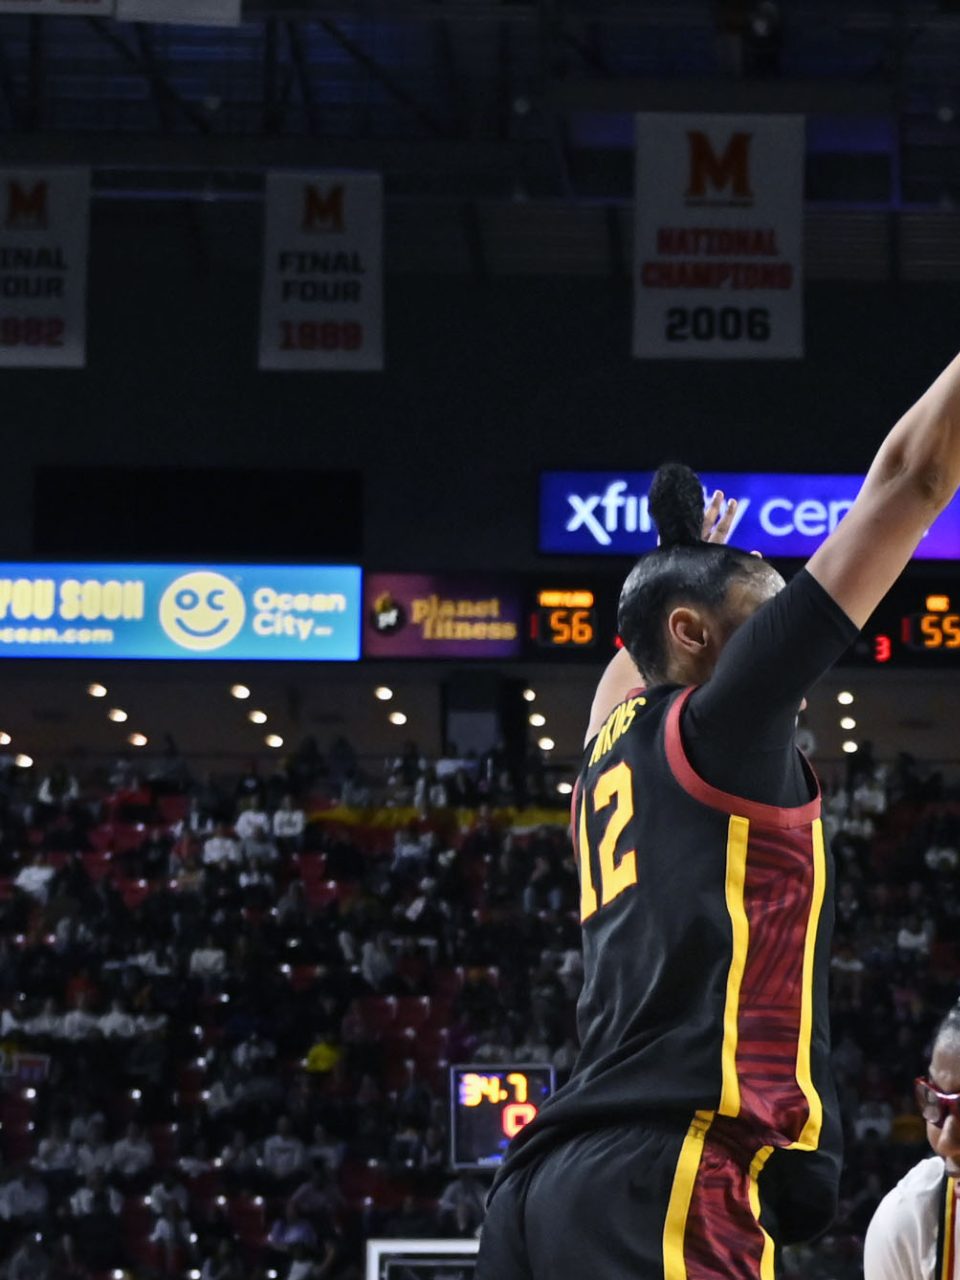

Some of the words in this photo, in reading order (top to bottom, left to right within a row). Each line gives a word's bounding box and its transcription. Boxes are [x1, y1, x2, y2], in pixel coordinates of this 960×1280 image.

[687, 130, 752, 200] M
[304, 183, 344, 232] M
[656, 228, 778, 256] NATIONAL
[278, 251, 365, 274] FINAL
[642, 262, 793, 290] CHAMPIONS
[282, 280, 361, 302] FOUR
[665, 307, 771, 342] 2006
[60, 581, 145, 620] SOON
[253, 588, 346, 613] Ocean
[253, 615, 314, 641] City
[549, 610, 593, 645] 56
[873, 634, 892, 663] 3
[579, 760, 638, 925] 12
[459, 1072, 528, 1107] 34.7
